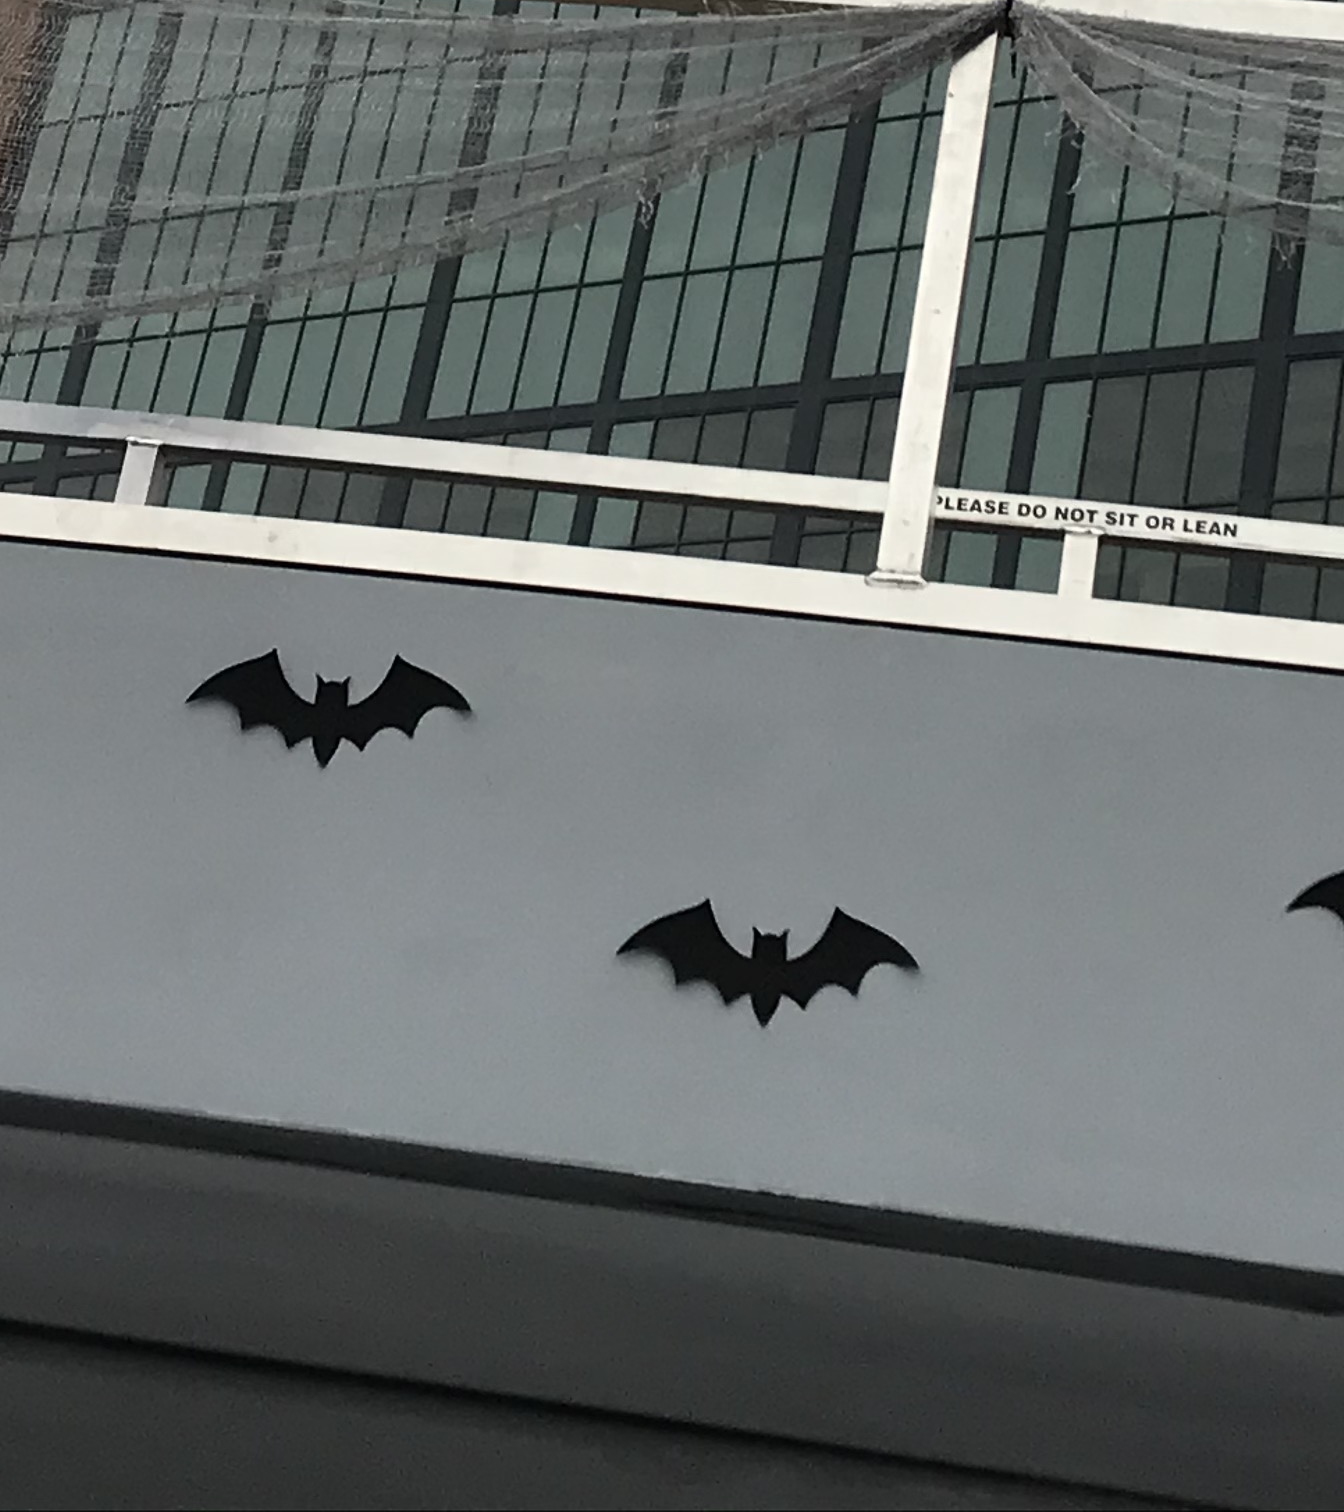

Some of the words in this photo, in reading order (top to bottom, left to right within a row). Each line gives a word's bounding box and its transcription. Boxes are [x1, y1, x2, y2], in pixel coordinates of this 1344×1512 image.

[1017, 503, 1047, 519] DO
[1054, 506, 1099, 524] NOT
[1105, 510, 1139, 527] SIT
[1145, 515, 1175, 531] OR
[1182, 518, 1238, 538] LEAN
